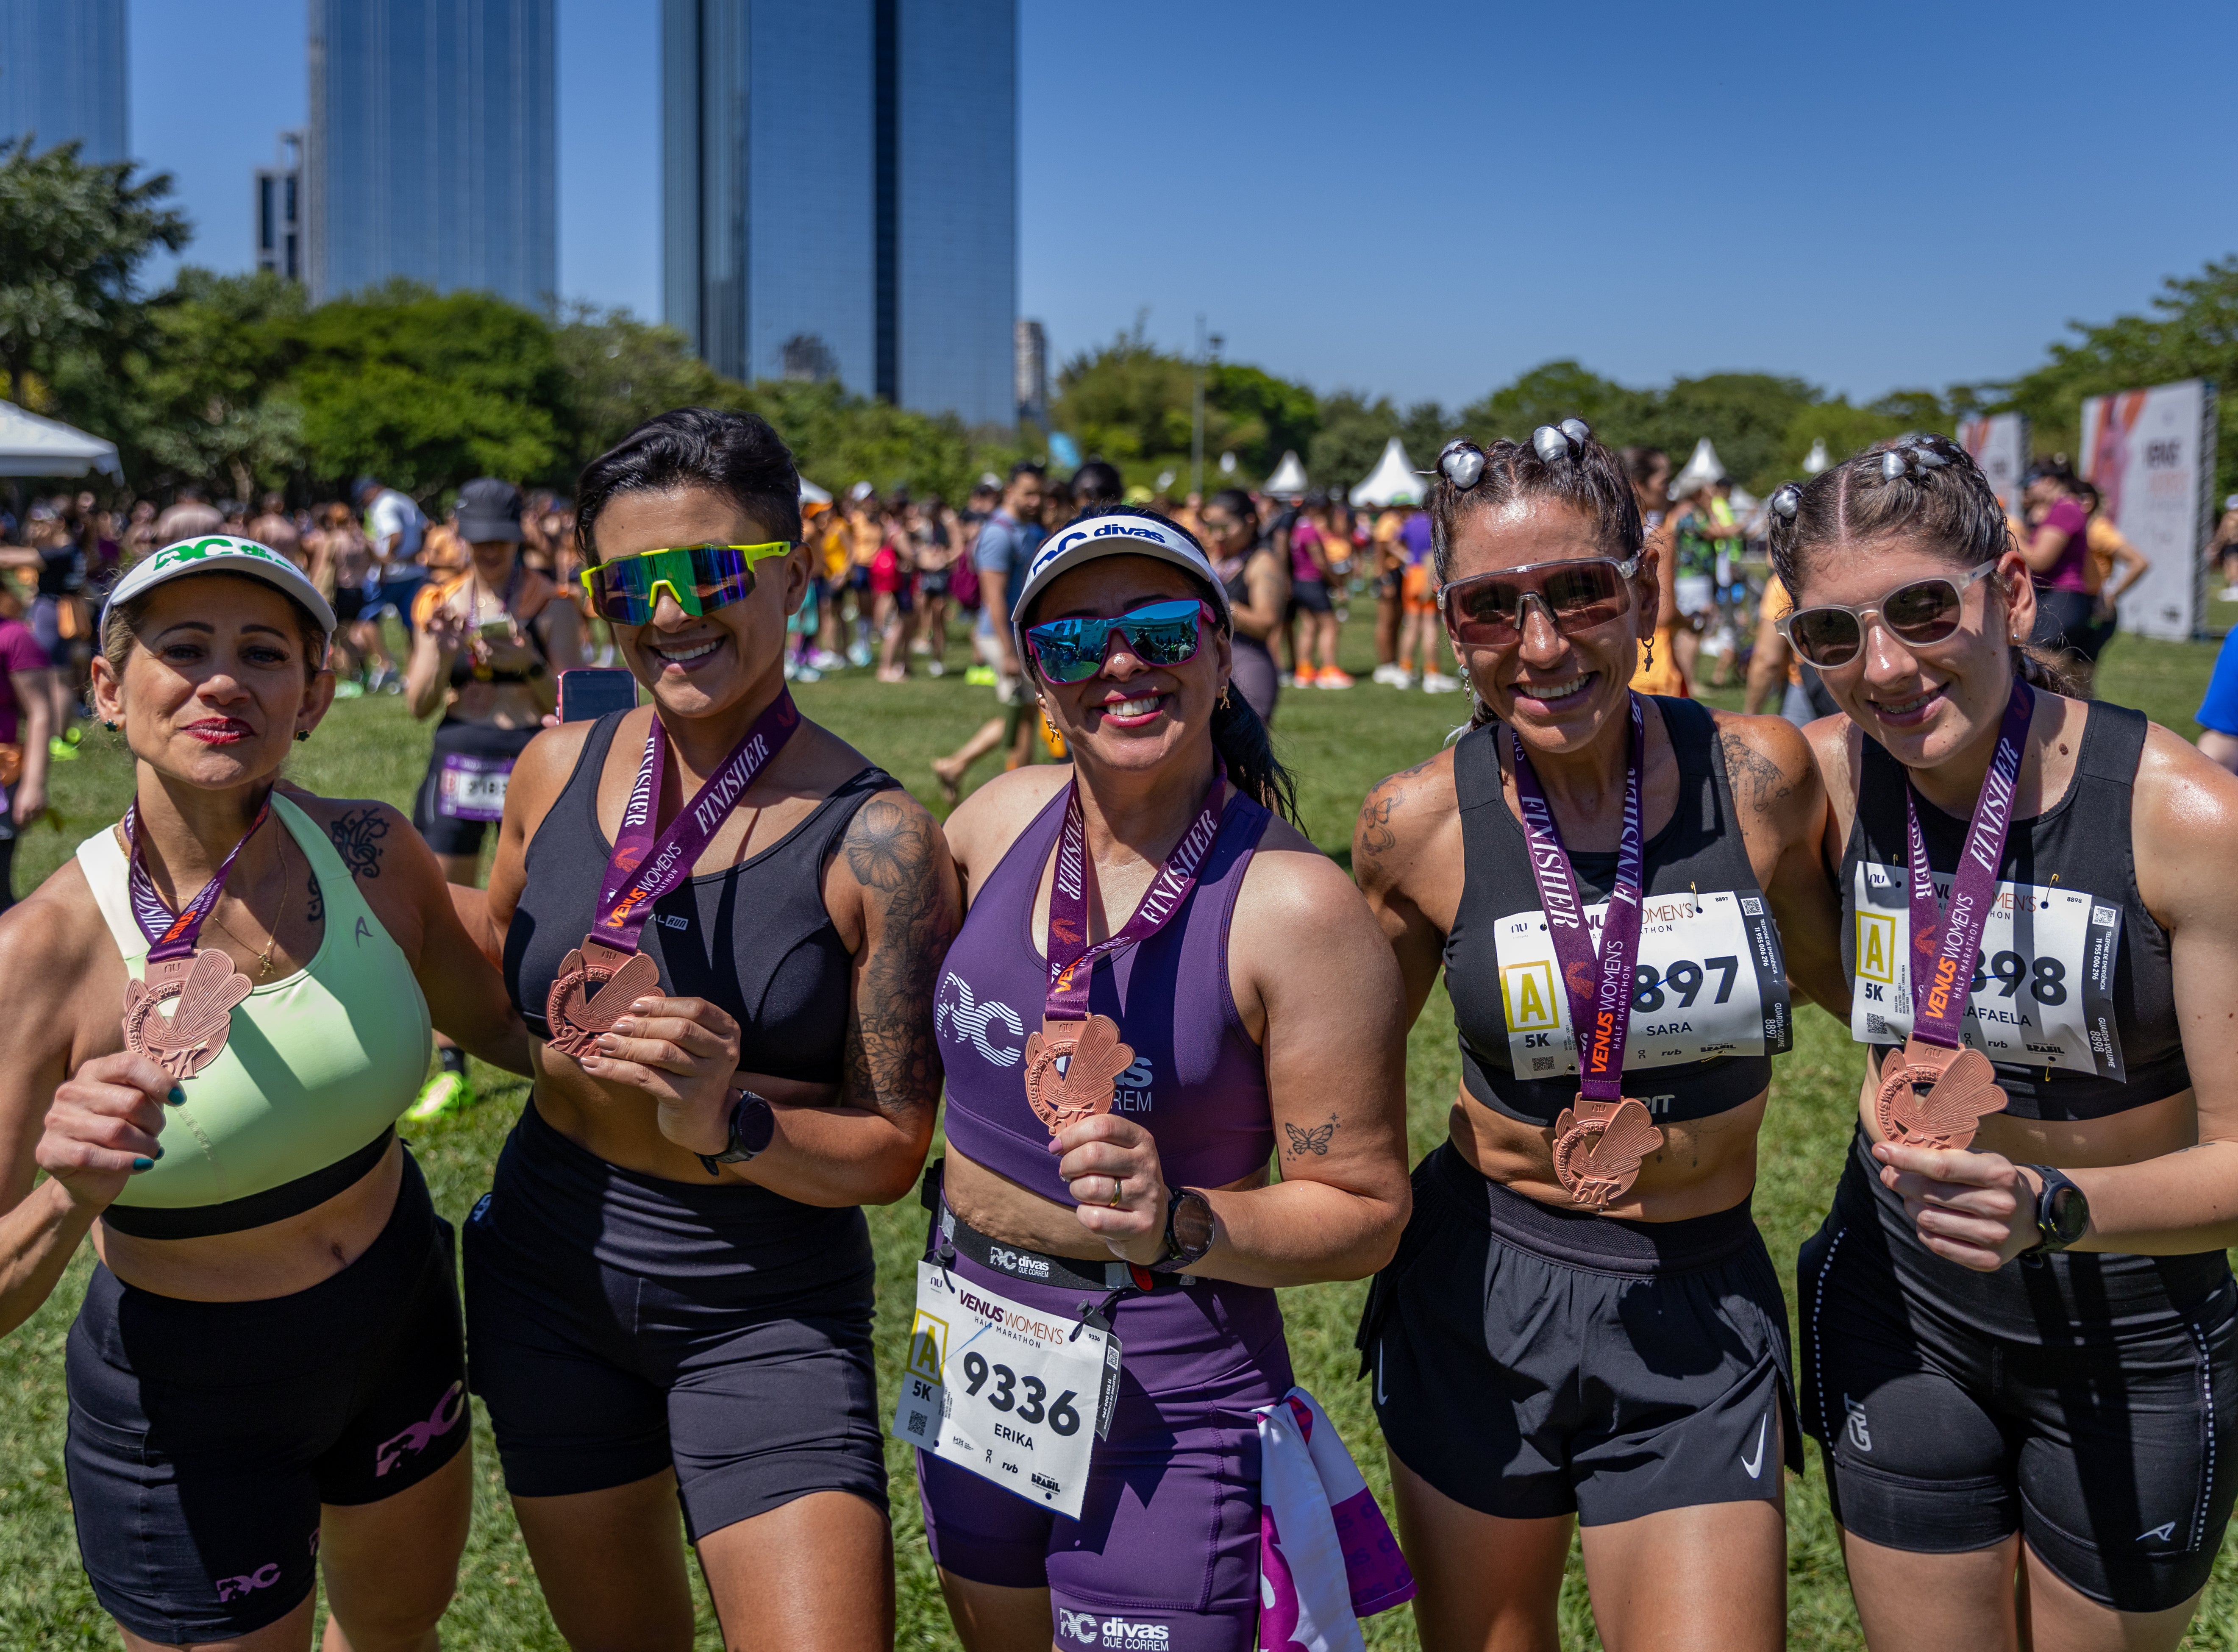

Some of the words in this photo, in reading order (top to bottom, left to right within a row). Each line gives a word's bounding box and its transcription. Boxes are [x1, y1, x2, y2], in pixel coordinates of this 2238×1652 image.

[1094, 524, 1166, 544] divas
[625, 737, 656, 828] FINISHER
[694, 733, 769, 836] FINISHER
[1970, 737, 2018, 874] FINISHER
[1059, 795, 1086, 900] FINISHER
[1139, 809, 1218, 924] FINISHER
[1521, 795, 1579, 928] FINISHER
[651, 868, 678, 898] MARATHON
[1760, 918, 1769, 940] TELEFONE
[1767, 947, 1778, 974] EMERGÊNCIA
[1865, 924, 1884, 973] A
[1761, 956, 1769, 966] 296
[1953, 975, 1965, 999] HALF
[1960, 922, 1979, 972] MARATHON
[589, 968, 608, 979] 2025
[1632, 955, 1738, 1014] 897
[157, 985, 179, 996] 2025
[1520, 973, 1548, 1023] A
[1616, 965, 1631, 1021] MARATHON
[1865, 982, 1884, 1002] 5K
[1774, 1003, 1785, 1048] GUARDA-VOLUME
[1963, 1006, 2032, 1027] AFAELA
[1525, 1033, 1551, 1048] 5K
[1613, 1025, 1622, 1049] HALF
[1646, 1022, 1693, 1036] SARA
[1765, 1019, 1777, 1039] 8897
[1054, 1045, 1071, 1054] 2025
[2026, 1044, 2065, 1054] BRASIL
[2090, 1030, 2105, 1053] 8898
[2098, 1018, 2115, 1068] GUARDA-VOLUME
[1915, 1069, 1937, 1080] 2025
[1585, 1124, 1605, 1132] 2025
[1572, 1176, 1621, 1205] 5K
[1018, 1256, 1049, 1271] divas
[1018, 1266, 1028, 1274] QUE
[1029, 1269, 1049, 1278] CORREM
[975, 1316, 993, 1329] HALF
[996, 1326, 1041, 1349] MARATHON
[1088, 1333, 1100, 1342] 9336
[917, 1325, 936, 1374] A
[912, 1380, 931, 1402] 5K
[963, 1351, 1081, 1436] 9336
[995, 1423, 1034, 1451] ERIKA
[1031, 1473, 1061, 1493] BRASIL
[1102, 1617, 1169, 1640] divas
[1103, 1636, 1122, 1648] QUE
[1125, 1638, 1169, 1651] CORREM
